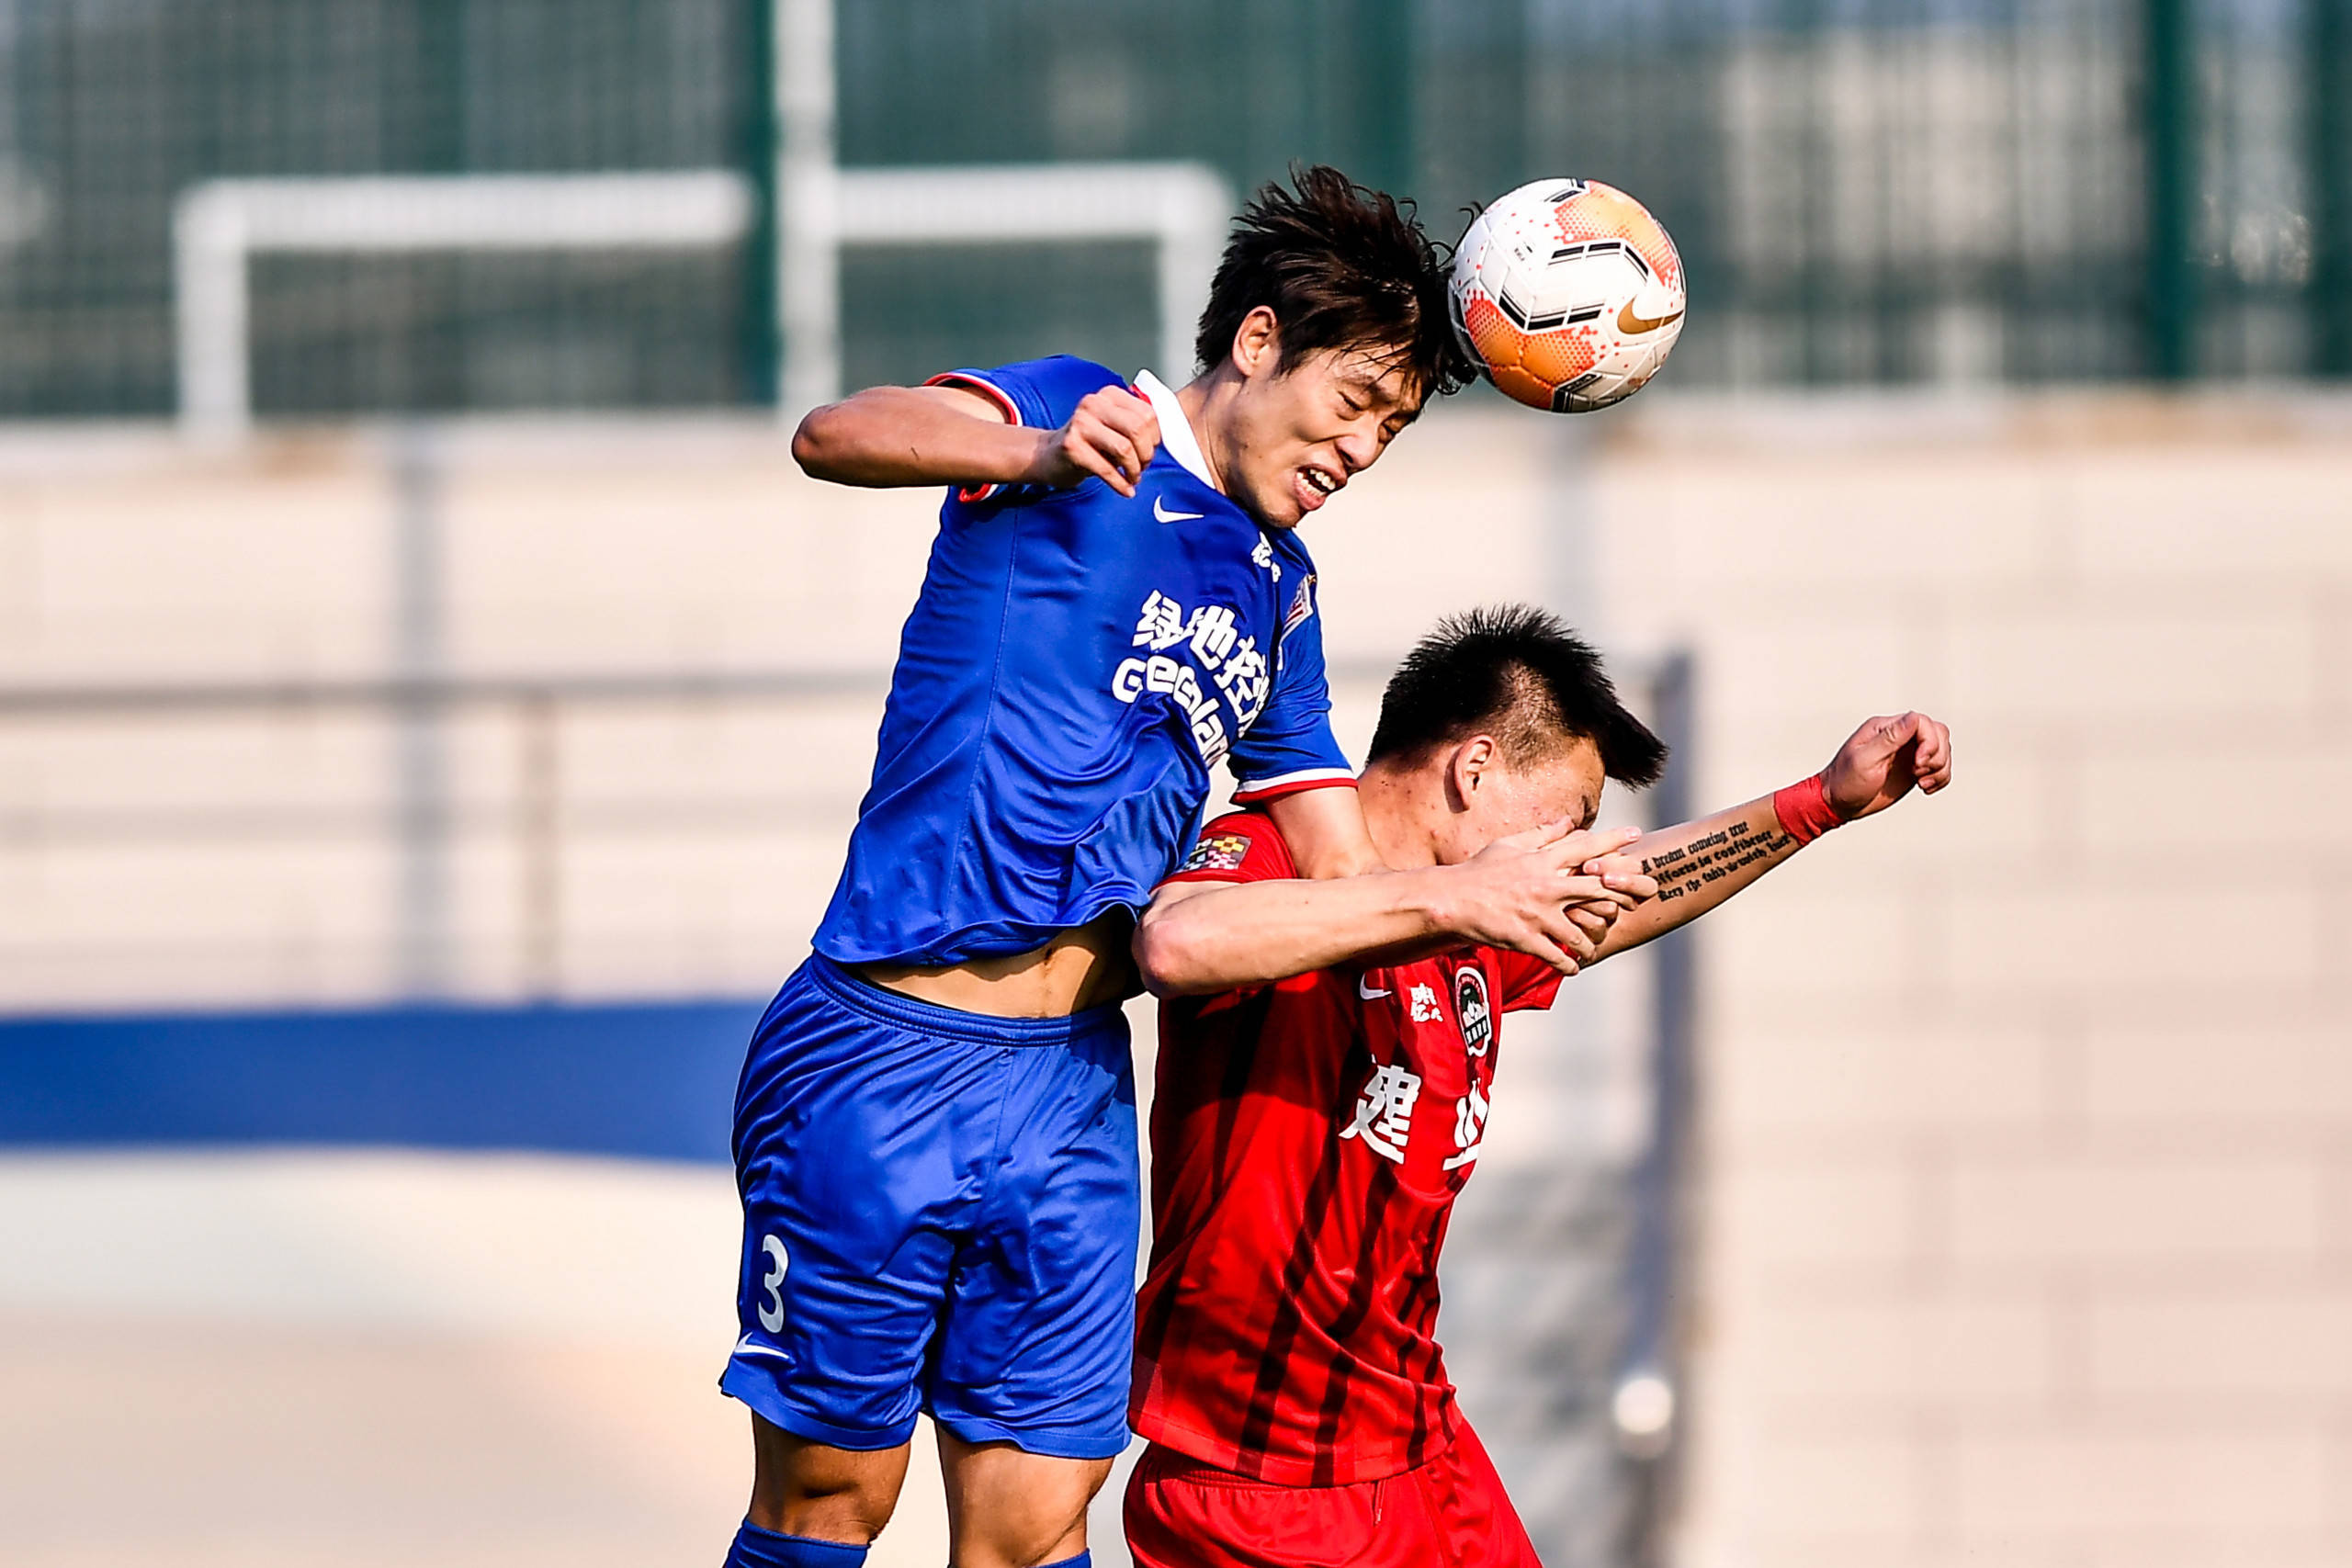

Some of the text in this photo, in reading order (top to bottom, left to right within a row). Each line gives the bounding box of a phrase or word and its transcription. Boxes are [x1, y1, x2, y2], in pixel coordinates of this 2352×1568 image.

[1132, 589, 1270, 739] 绿地控
[1641, 857, 1652, 874] A
[1652, 847, 1686, 869] dream
[1728, 821, 1749, 837] true
[1698, 854, 1713, 867] in
[1713, 830, 1773, 861] confidence
[1685, 879, 1702, 892] the
[758, 1234, 789, 1333] 3
